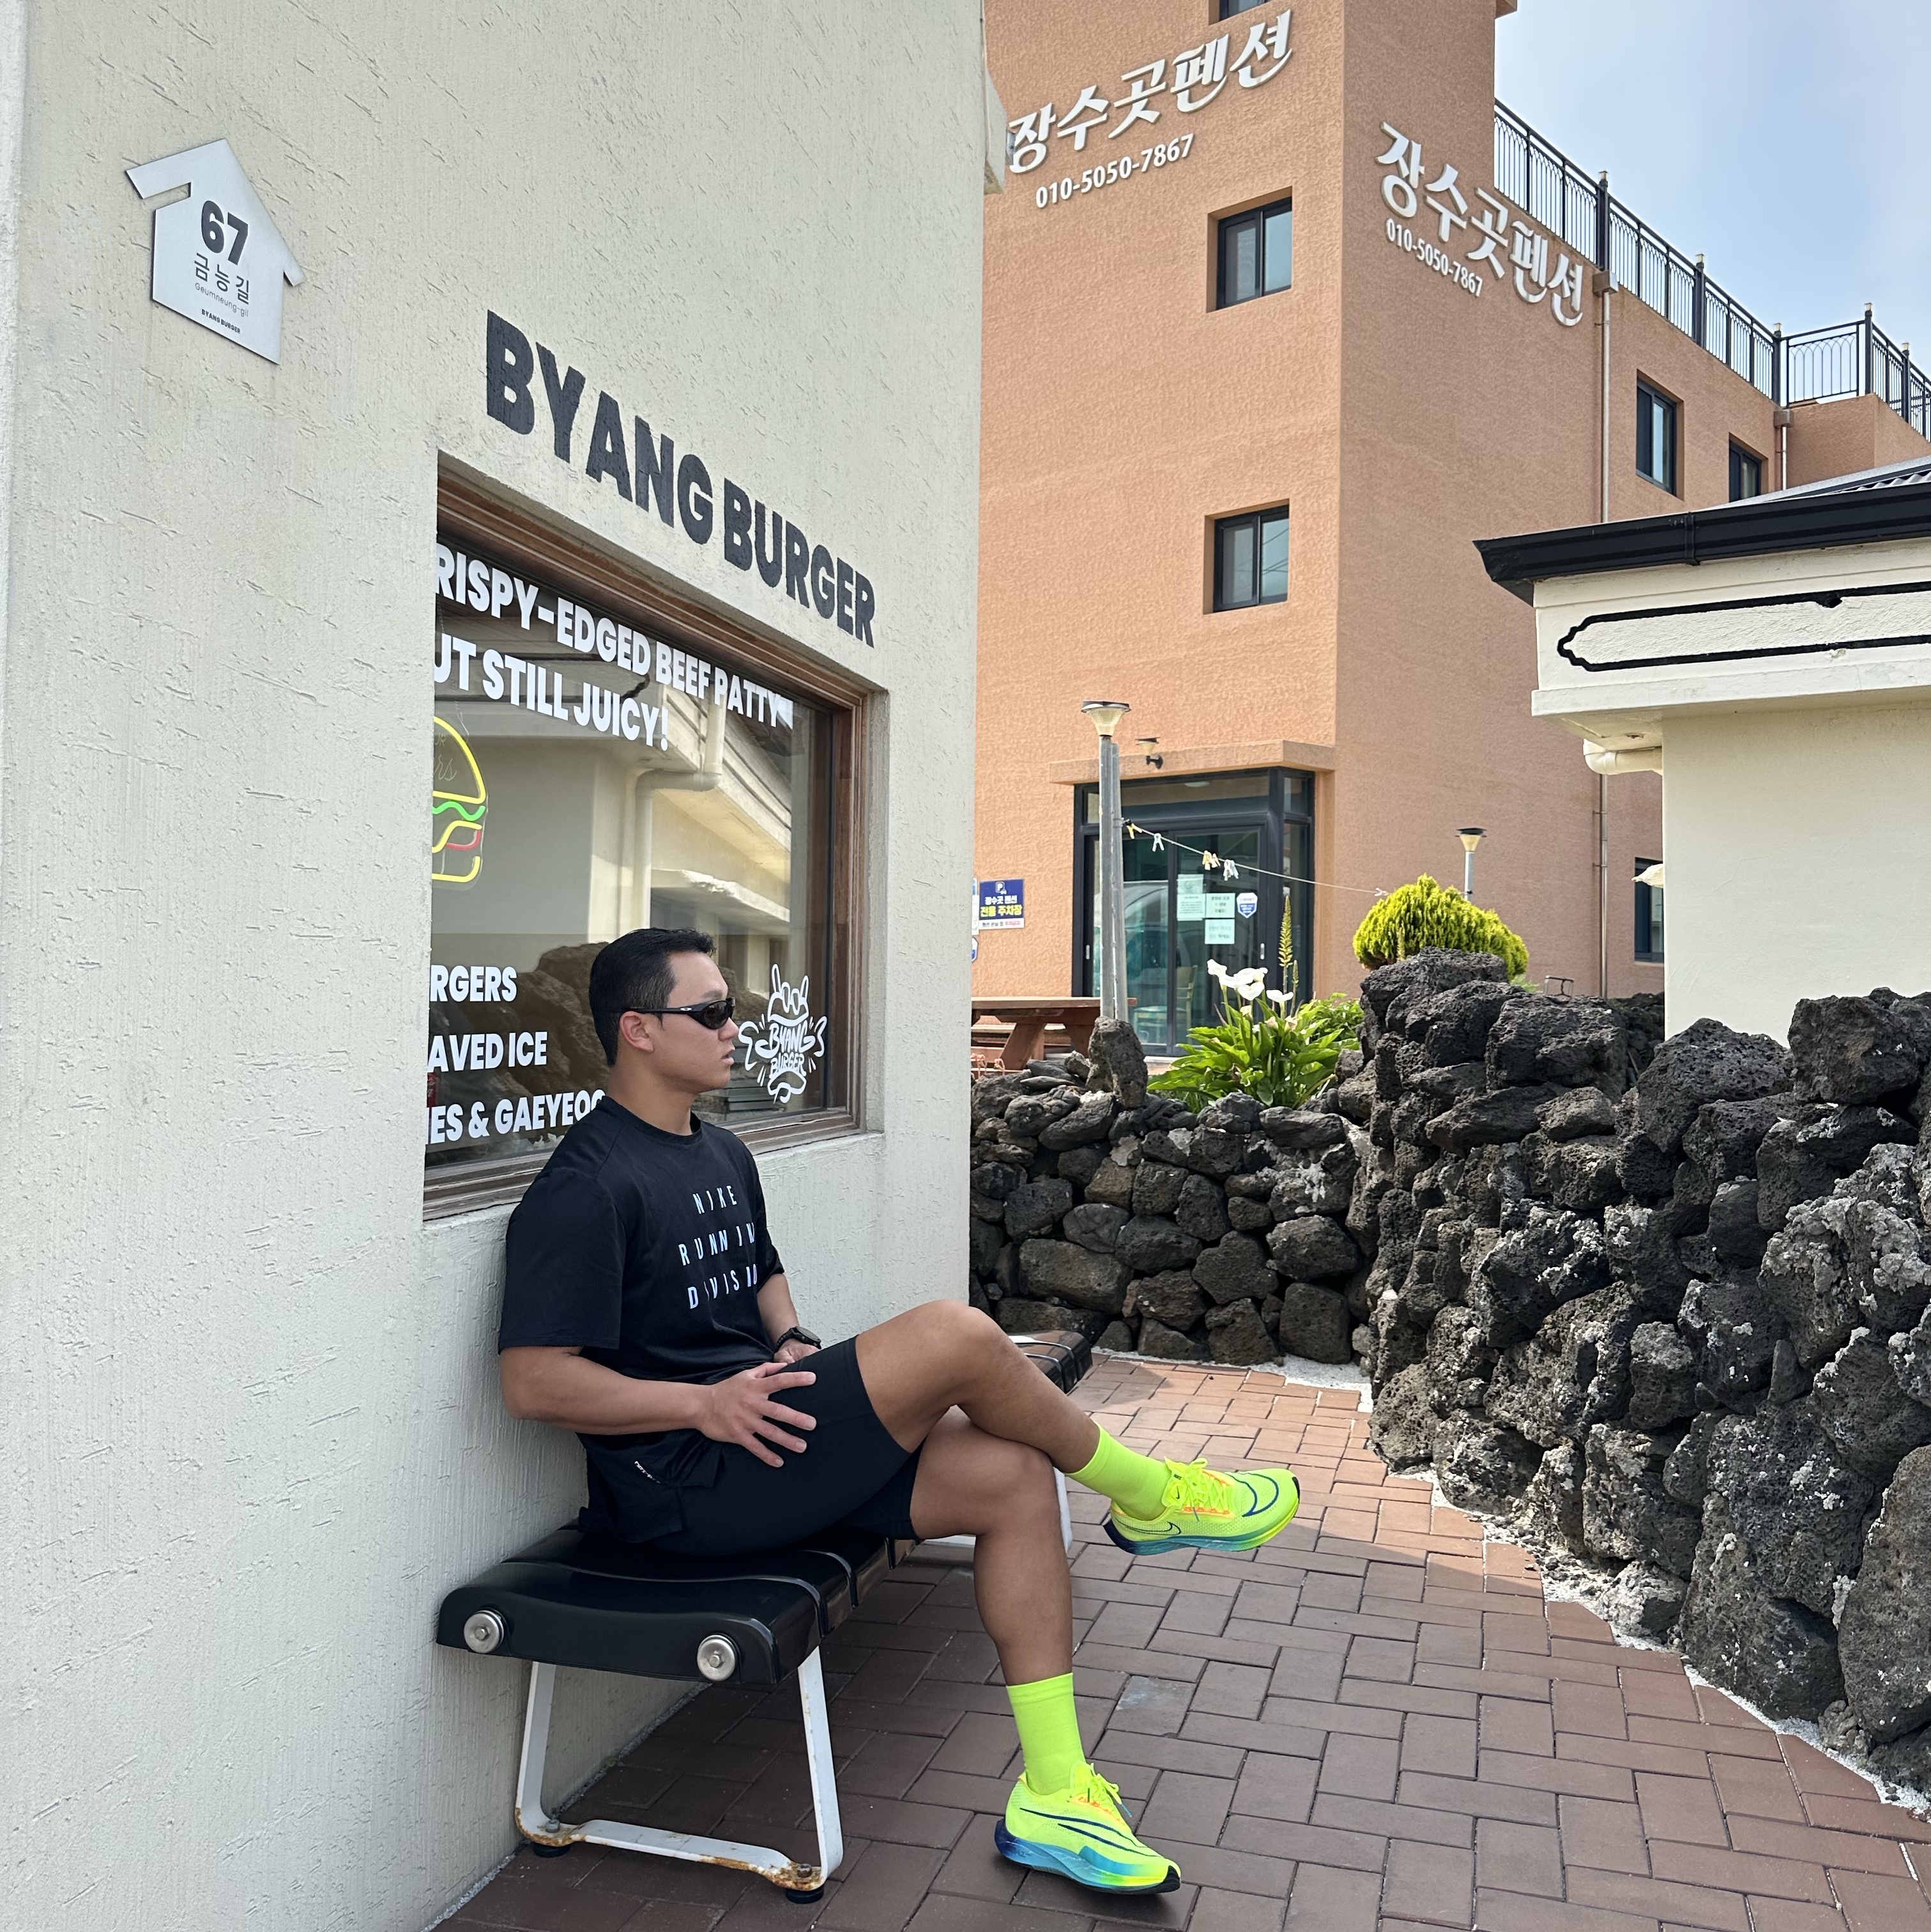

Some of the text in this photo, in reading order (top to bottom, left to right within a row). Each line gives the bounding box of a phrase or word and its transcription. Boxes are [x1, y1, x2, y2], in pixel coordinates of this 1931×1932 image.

[1007, 9, 1293, 174] 장수곳펜션
[1035, 133, 1194, 208] 010-5050-7867
[201, 200, 248, 266] 67
[1375, 121, 1584, 327] 장수곳펜션
[194, 252, 249, 305] 금능길
[1385, 218, 1483, 297] 010-5050-7867
[195, 282, 249, 318] Geumneung-gil
[201, 308, 241, 334] BYANG BURGER
[486, 309, 874, 648] BYANG BURGER
[482, 649, 569, 721] STILL
[573, 681, 669, 751] JUICY!
[656, 641, 711, 700] BEEF
[714, 667, 781, 728] PATTY
[508, 1031, 548, 1067] ICE
[755, 1019, 816, 1059] BYANG
[768, 1052, 807, 1079] BURGER
[468, 1101, 491, 1139] &
[692, 1185, 738, 1214] NIKE
